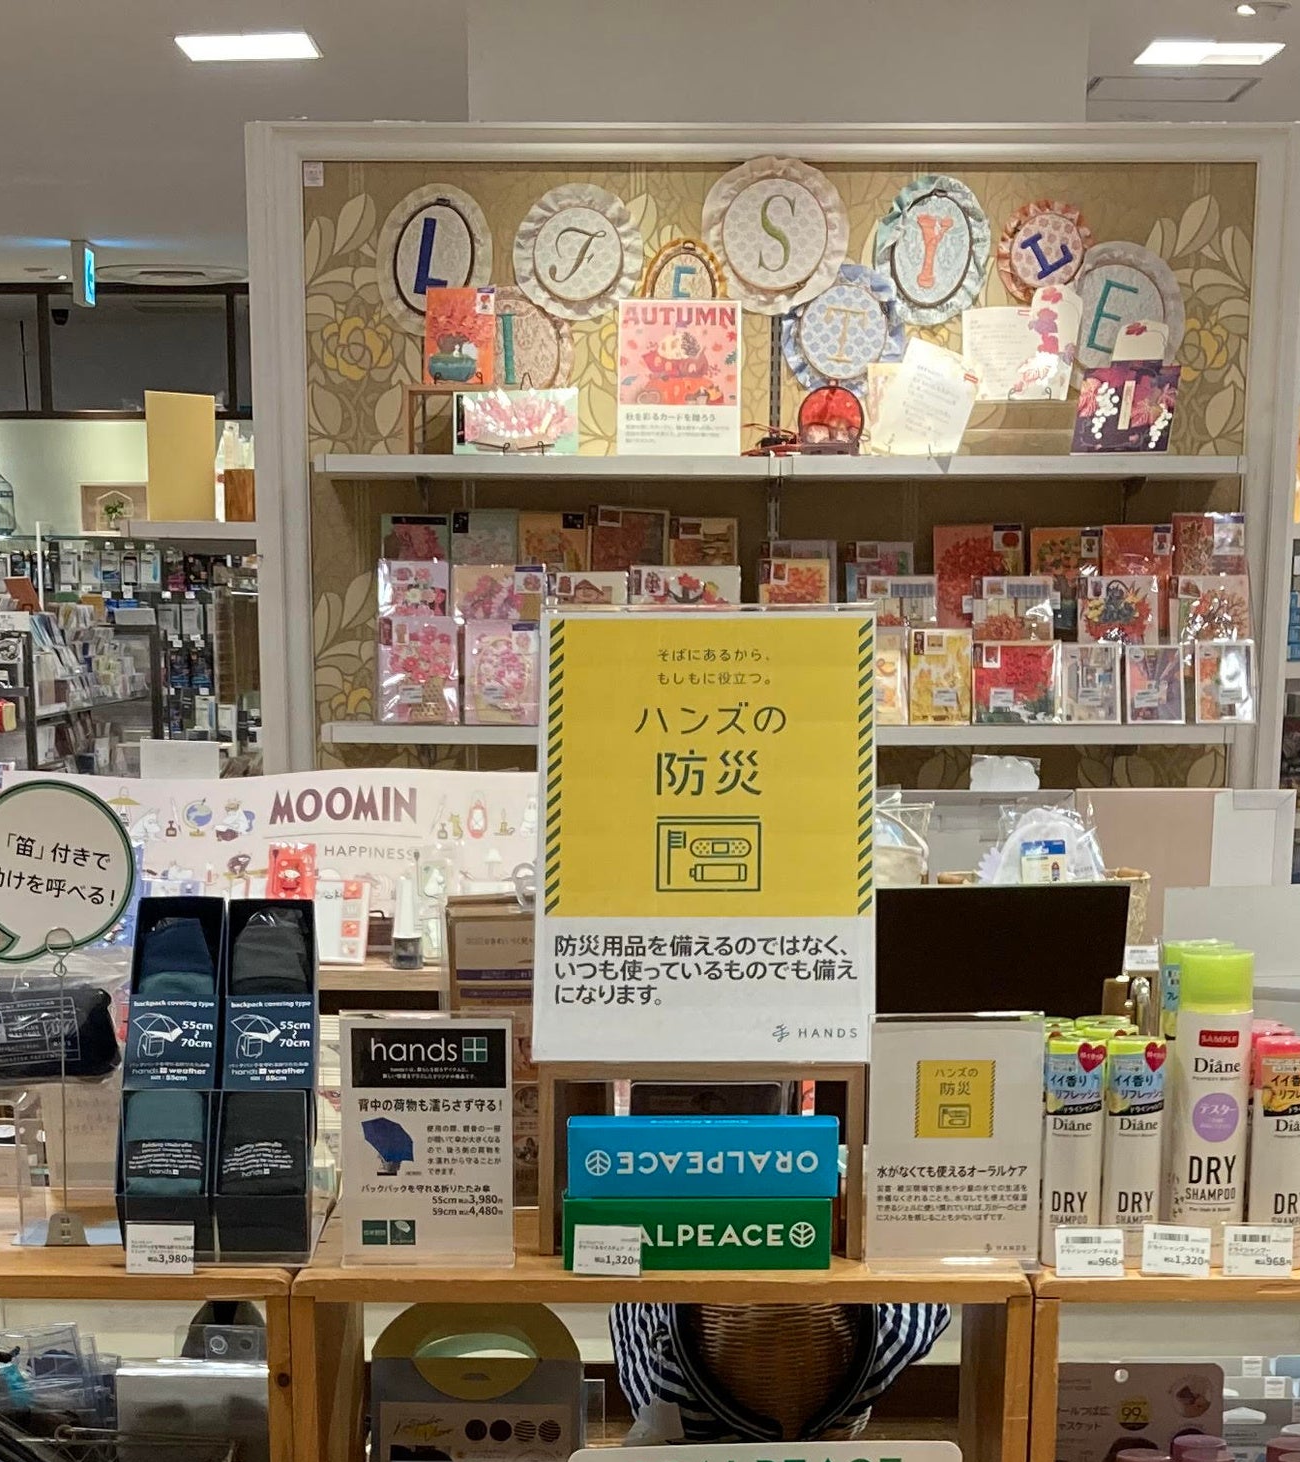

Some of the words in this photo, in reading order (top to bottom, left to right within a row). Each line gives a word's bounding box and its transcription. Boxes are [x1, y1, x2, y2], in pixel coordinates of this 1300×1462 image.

[623, 307, 735, 328] AUTUMN
[658, 648, 770, 663] そばにあるから、
[658, 671, 772, 686] もしもに役立つ。
[634, 701, 787, 735] ハンズの
[656, 749, 762, 796] 防災
[269, 787, 417, 825] MOOMIN
[4, 832, 112, 872] 「笛」付きで
[324, 845, 418, 861] HAPPINESS
[555, 935, 849, 957] 防災用品を備えるのではなく、
[555, 960, 857, 981] いつも使っているものでも備え
[555, 985, 662, 1006] になります。
[182, 1021, 213, 1030] 55cm
[280, 1021, 311, 1030] 55cm
[798, 1028, 858, 1039] HANDS
[181, 1039, 212, 1048] 70cm
[279, 1039, 310, 1048] 70cm
[1201, 1035, 1237, 1044] SAMPLE
[371, 1037, 457, 1061] hands
[935, 1067, 978, 1077] ハンズの
[1194, 1057, 1241, 1073] Diâne
[1050, 1074, 1088, 1086] イイ香り
[940, 1081, 971, 1096] 防災
[1200, 1104, 1237, 1115] テスター
[616, 1151, 819, 1175] ORALPEACE
[1189, 1155, 1236, 1185] DRY
[877, 1165, 1027, 1178] 水がなくても使えるオーラルケア
[1185, 1187, 1236, 1200] SHAMPOO
[1052, 1191, 1088, 1213] DRY
[1118, 1191, 1154, 1213] DRY
[641, 1221, 784, 1247] ALPEACE
